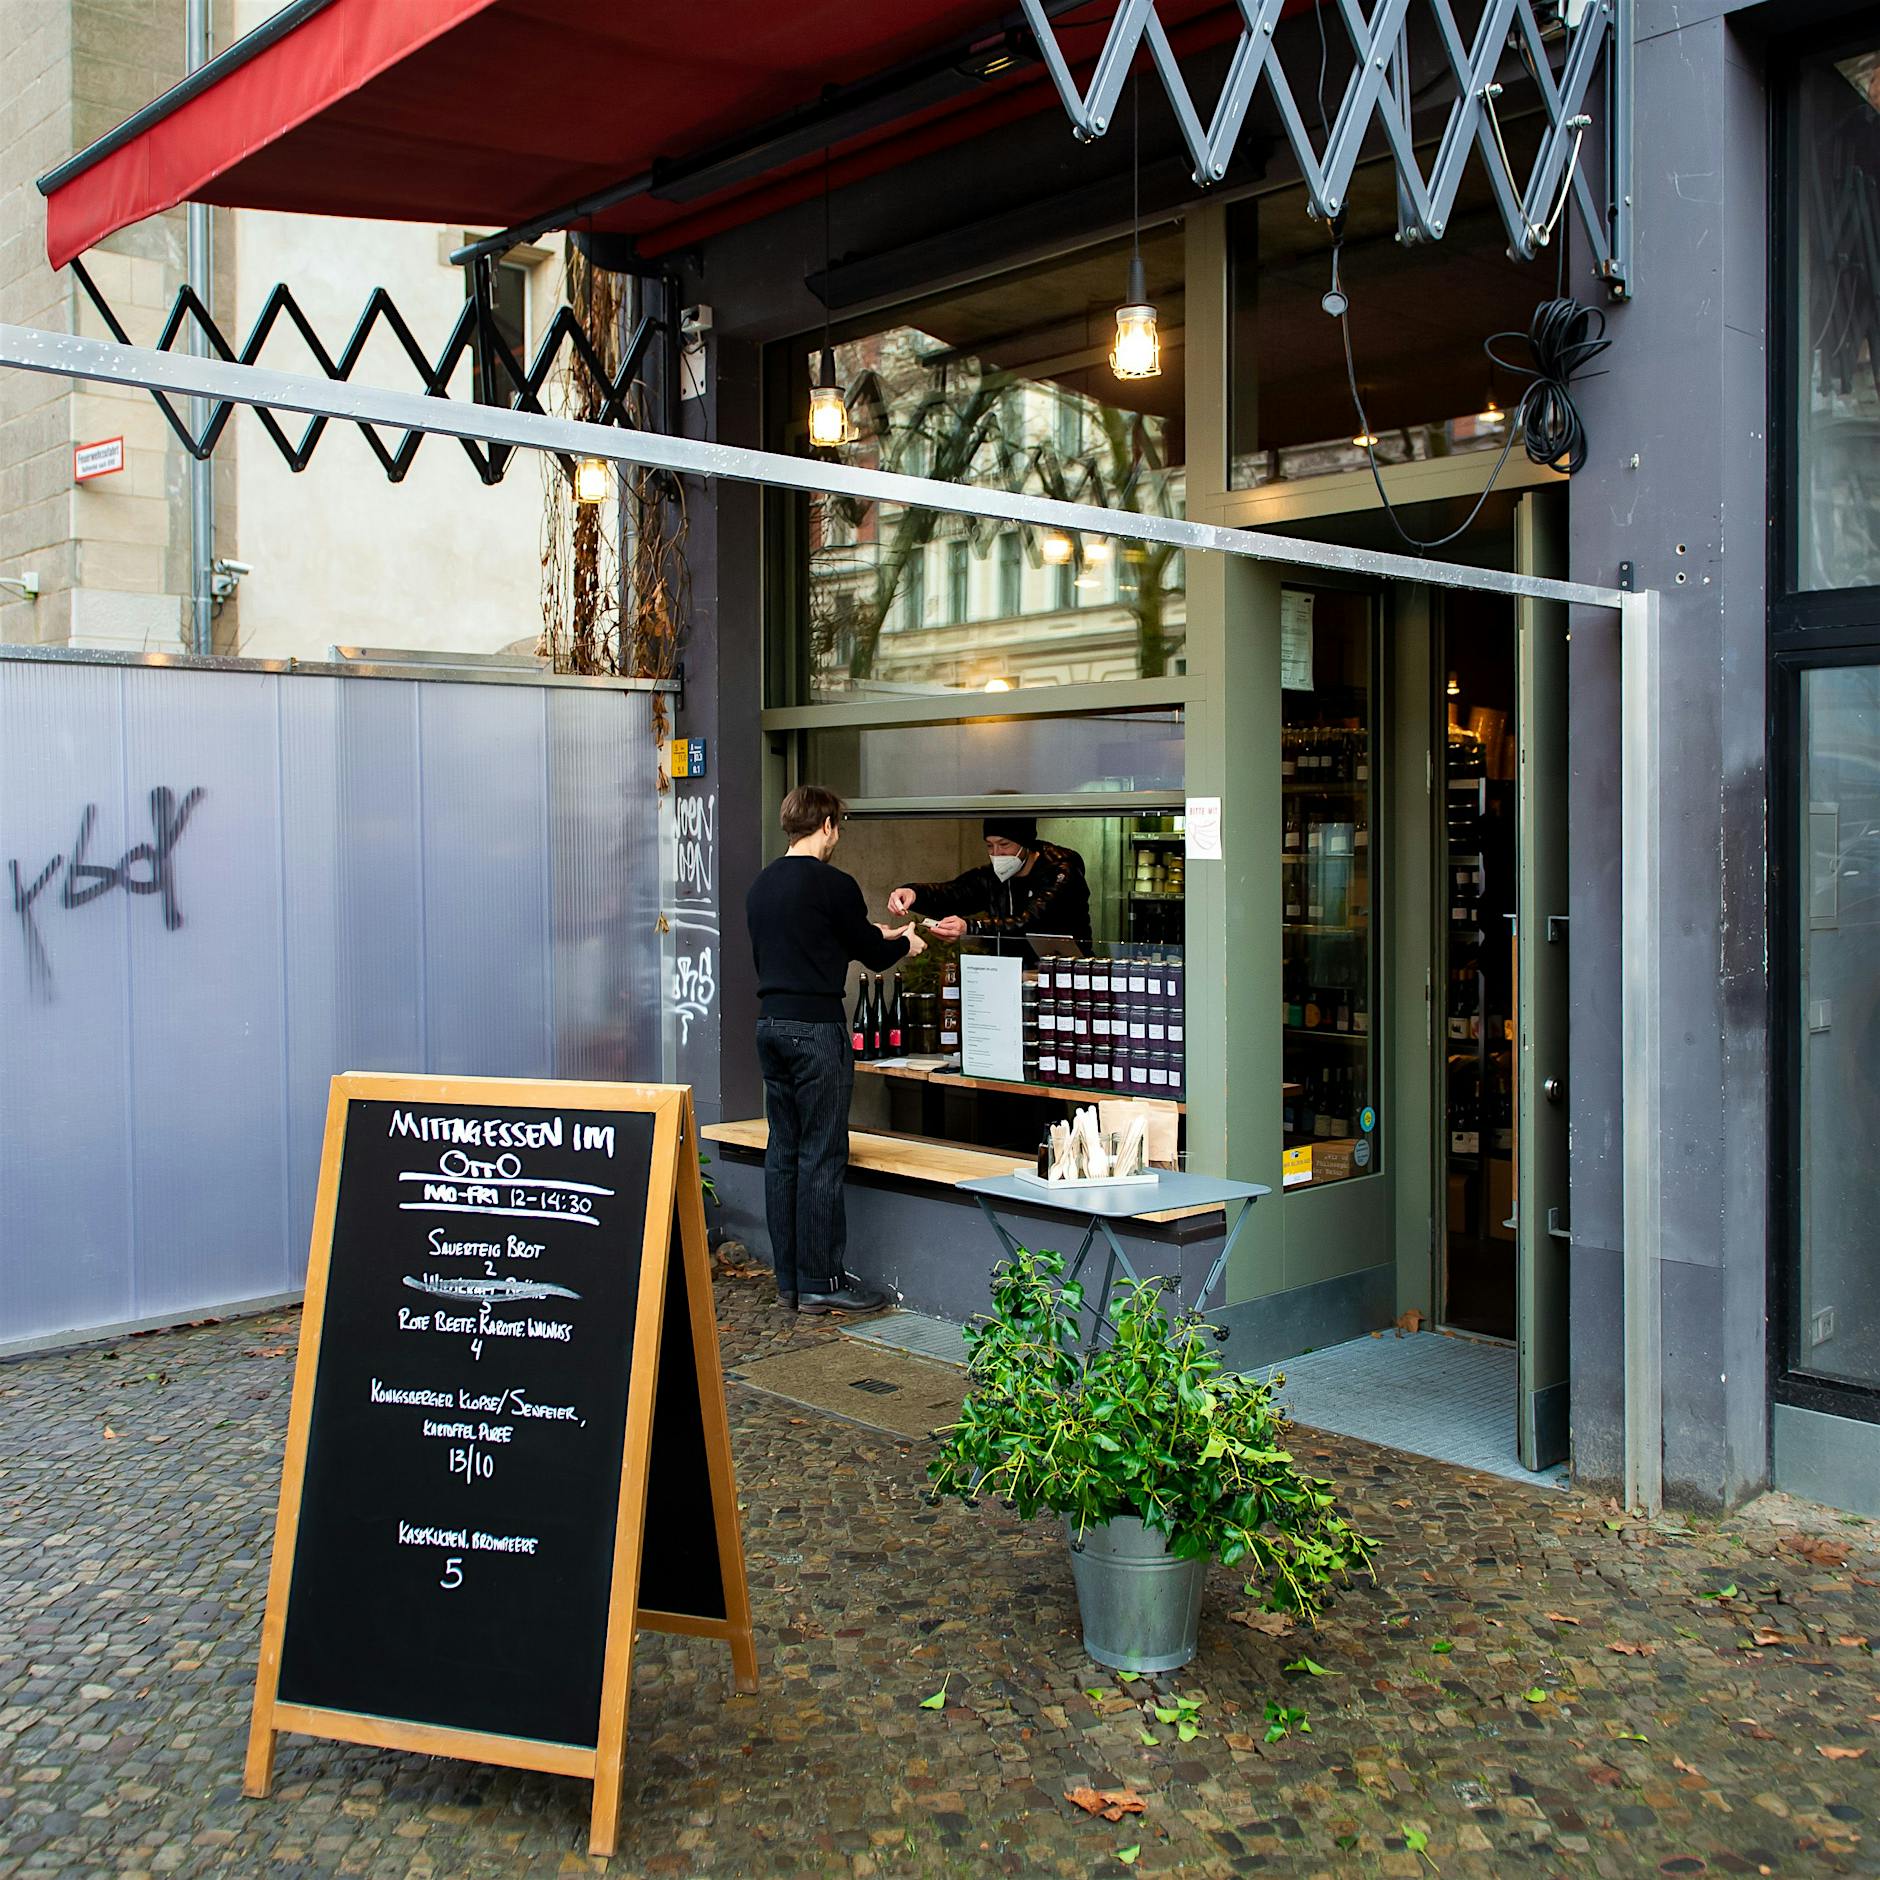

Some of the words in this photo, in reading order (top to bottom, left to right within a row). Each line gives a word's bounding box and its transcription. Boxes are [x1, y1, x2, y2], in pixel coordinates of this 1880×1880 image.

[388, 1109, 563, 1148] MITTAGESSEN
[572, 1123, 615, 1159] IM
[439, 1150, 522, 1178] OTTO
[510, 1189, 592, 1213] 12-14:30
[506, 1234, 546, 1259] BROT
[484, 1260, 498, 1277] 2
[398, 1307, 431, 1331] ROTE
[470, 1337, 483, 1361] 4
[449, 1443, 494, 1485] 13/10
[439, 1558, 463, 1589] 5
